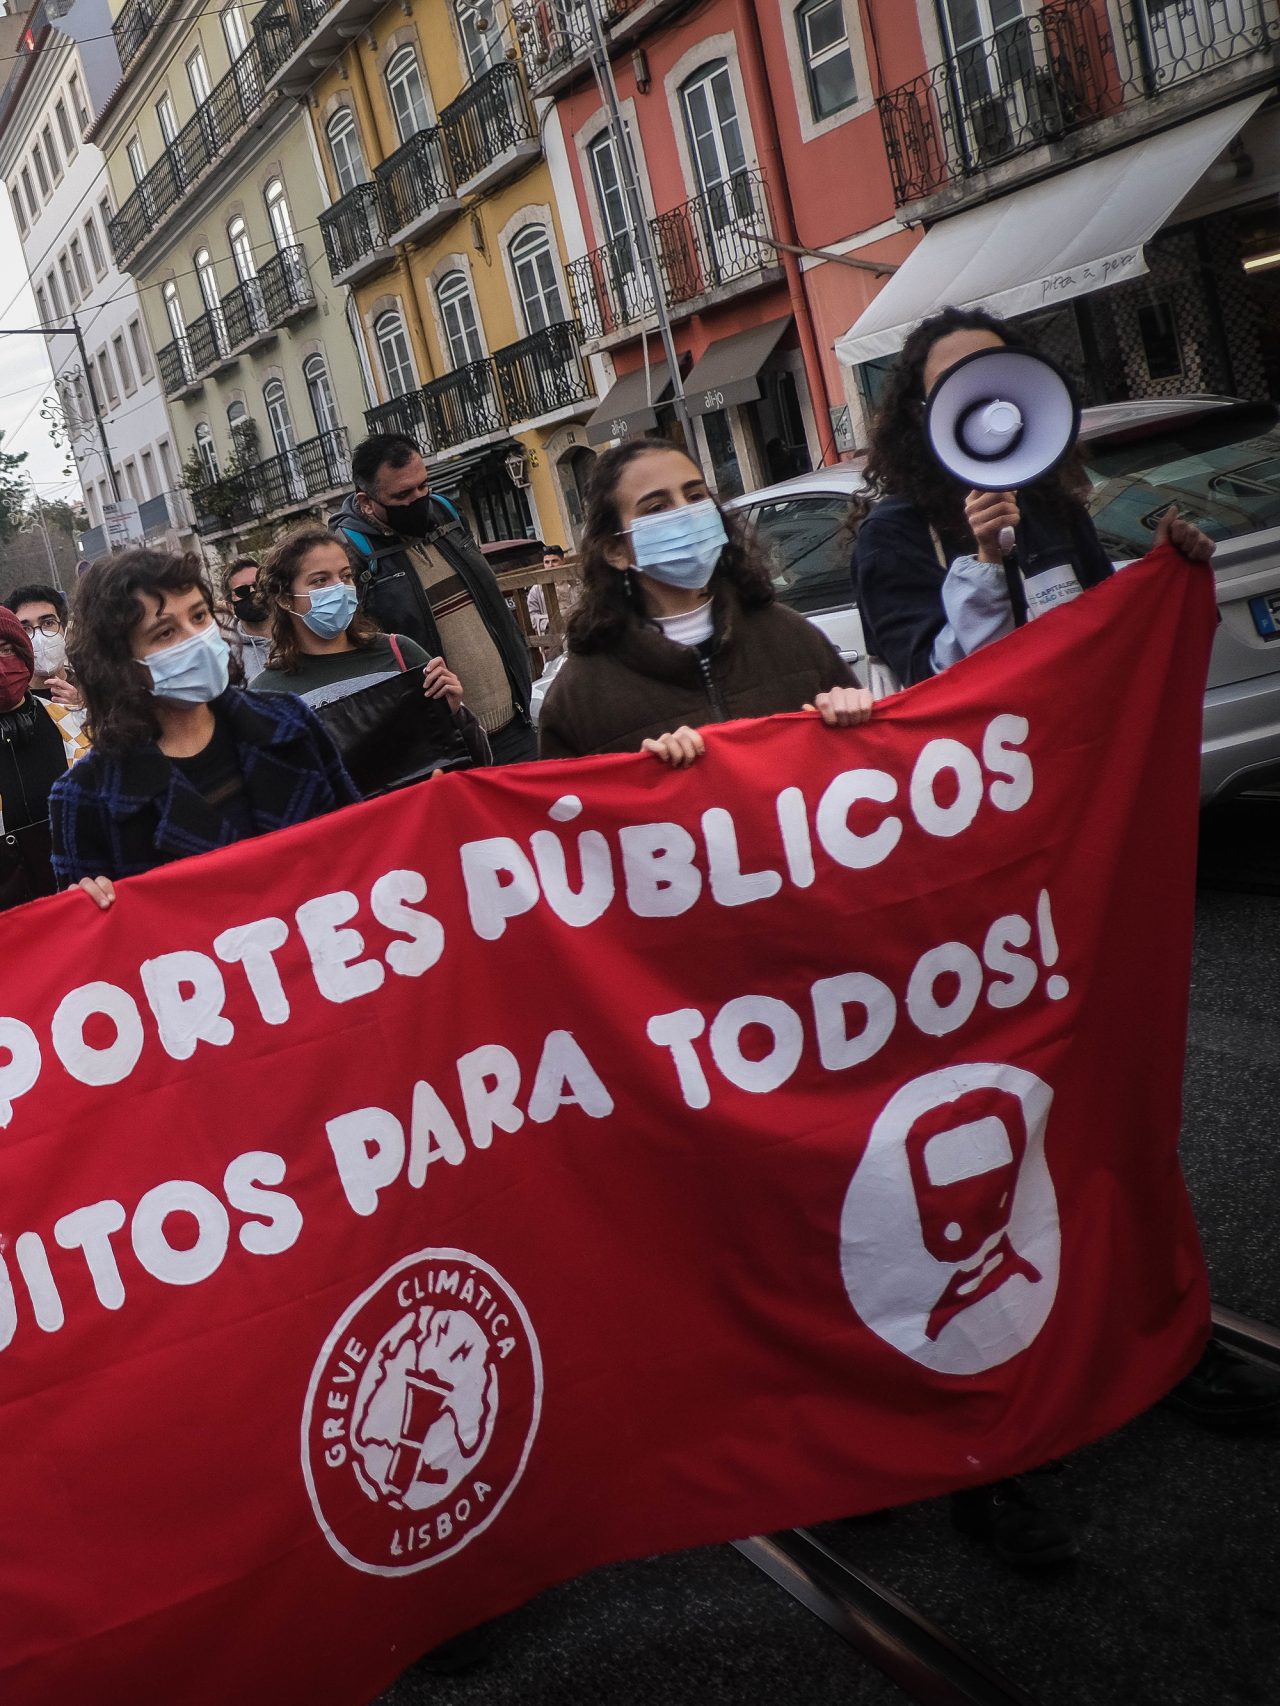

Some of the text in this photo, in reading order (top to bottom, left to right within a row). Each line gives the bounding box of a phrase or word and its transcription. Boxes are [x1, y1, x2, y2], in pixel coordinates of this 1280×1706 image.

[460, 714, 1034, 940] PÚBLICOS
[326, 1030, 614, 1216] PARA
[647, 889, 1069, 1109] TODOS!
[322, 1269, 516, 1468] GREVE CLIMÁTICA
[390, 1481, 492, 1556] LISBOA
